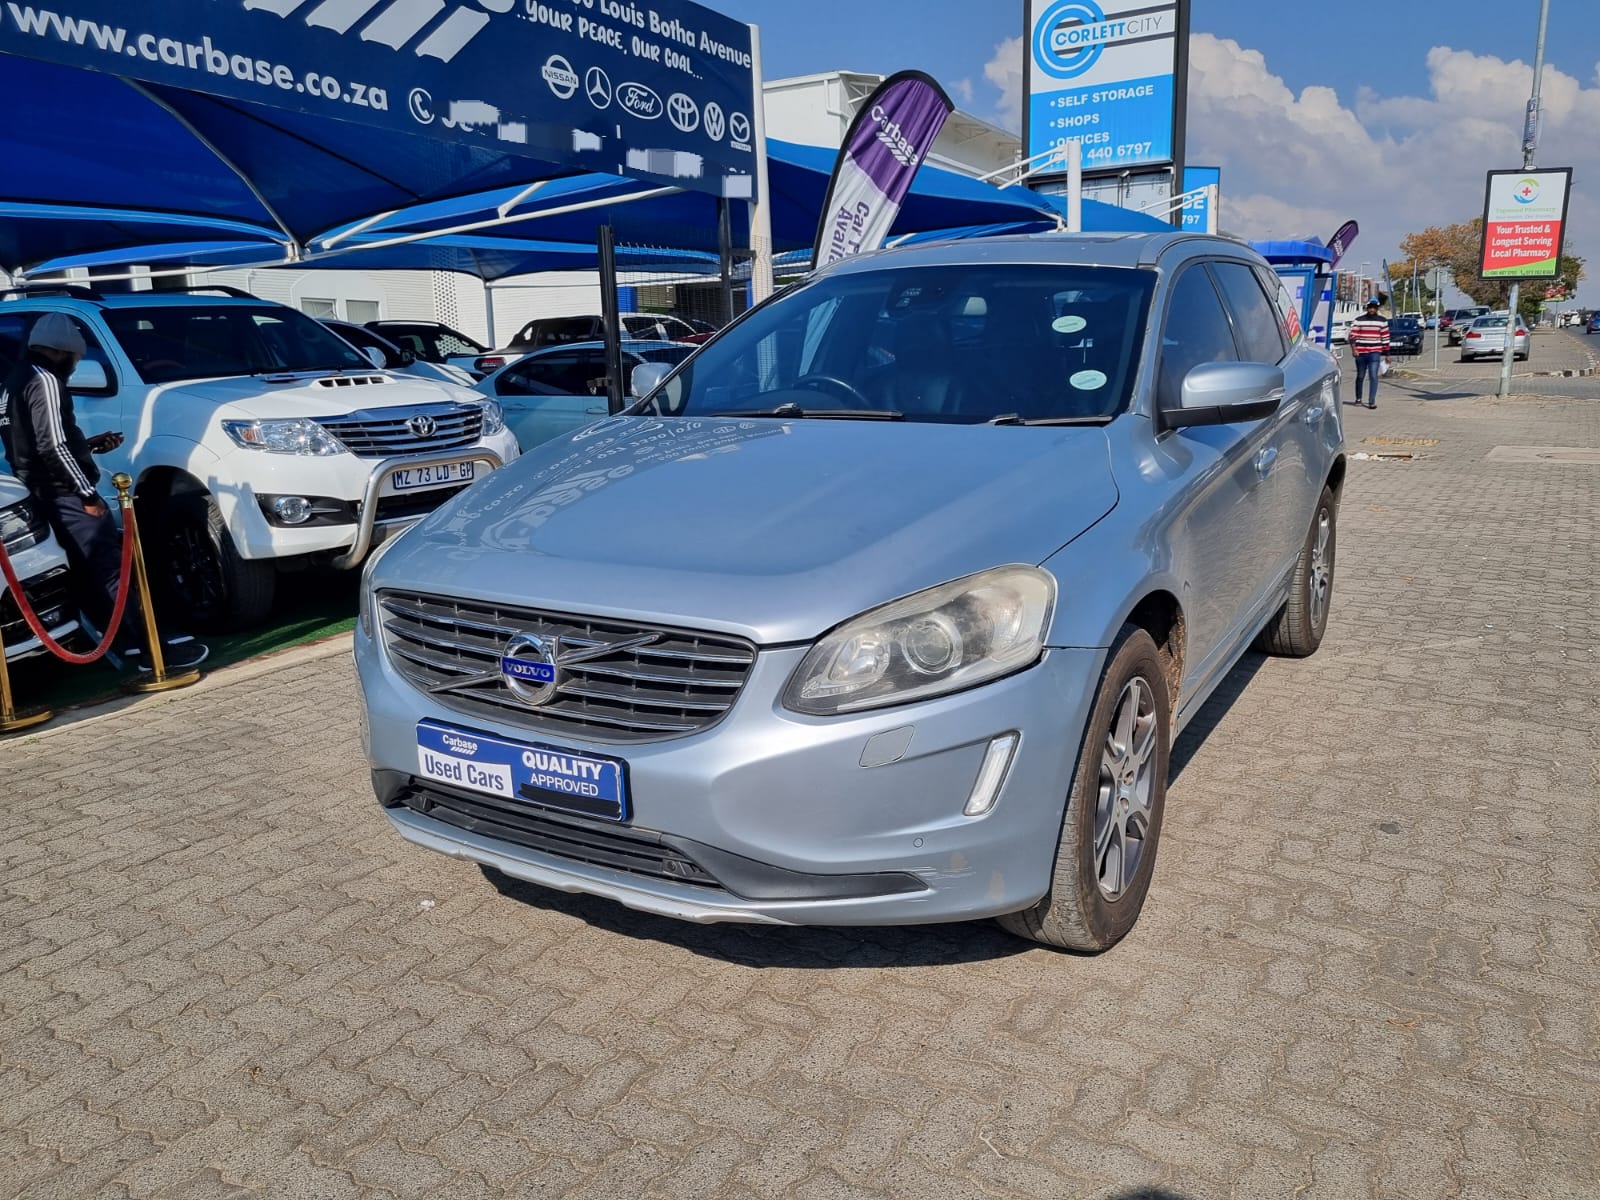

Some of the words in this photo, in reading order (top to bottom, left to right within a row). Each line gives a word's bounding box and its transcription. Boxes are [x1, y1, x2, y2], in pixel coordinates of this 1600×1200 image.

[632, 36, 660, 63] OUR
[649, 10, 696, 48] Botha
[700, 31, 751, 68] Avenue
[7, 3, 388, 111] www.carbase.co.za
[543, 69, 577, 86] NISSAN
[625, 86, 655, 113] Ford
[1057, 94, 1089, 108] SELF
[1092, 85, 1154, 103] STORAGE
[1057, 114, 1100, 128] SHOPS
[871, 105, 919, 166] Carbase
[1087, 146, 1113, 159] 440
[1117, 142, 1152, 156] 6797
[852, 201, 870, 236] Car
[1496, 225, 1513, 234] Your
[1515, 224, 1543, 234] Trusted
[1544, 224, 1551, 233] &
[1491, 237, 1522, 247] Longest
[1524, 236, 1553, 247] Serving
[1491, 249, 1511, 257] Local
[1513, 248, 1551, 258] Pharmacy
[396, 470, 411, 486] MZ
[417, 467, 431, 484] 73
[436, 465, 449, 481] LD
[460, 460, 473, 477] GP
[504, 661, 551, 679] VOLVO
[442, 734, 478, 751] Carbase
[424, 753, 462, 781] Used
[466, 763, 504, 791] Cars
[522, 751, 603, 781] QUALITY
[530, 773, 599, 797] APPROVED
